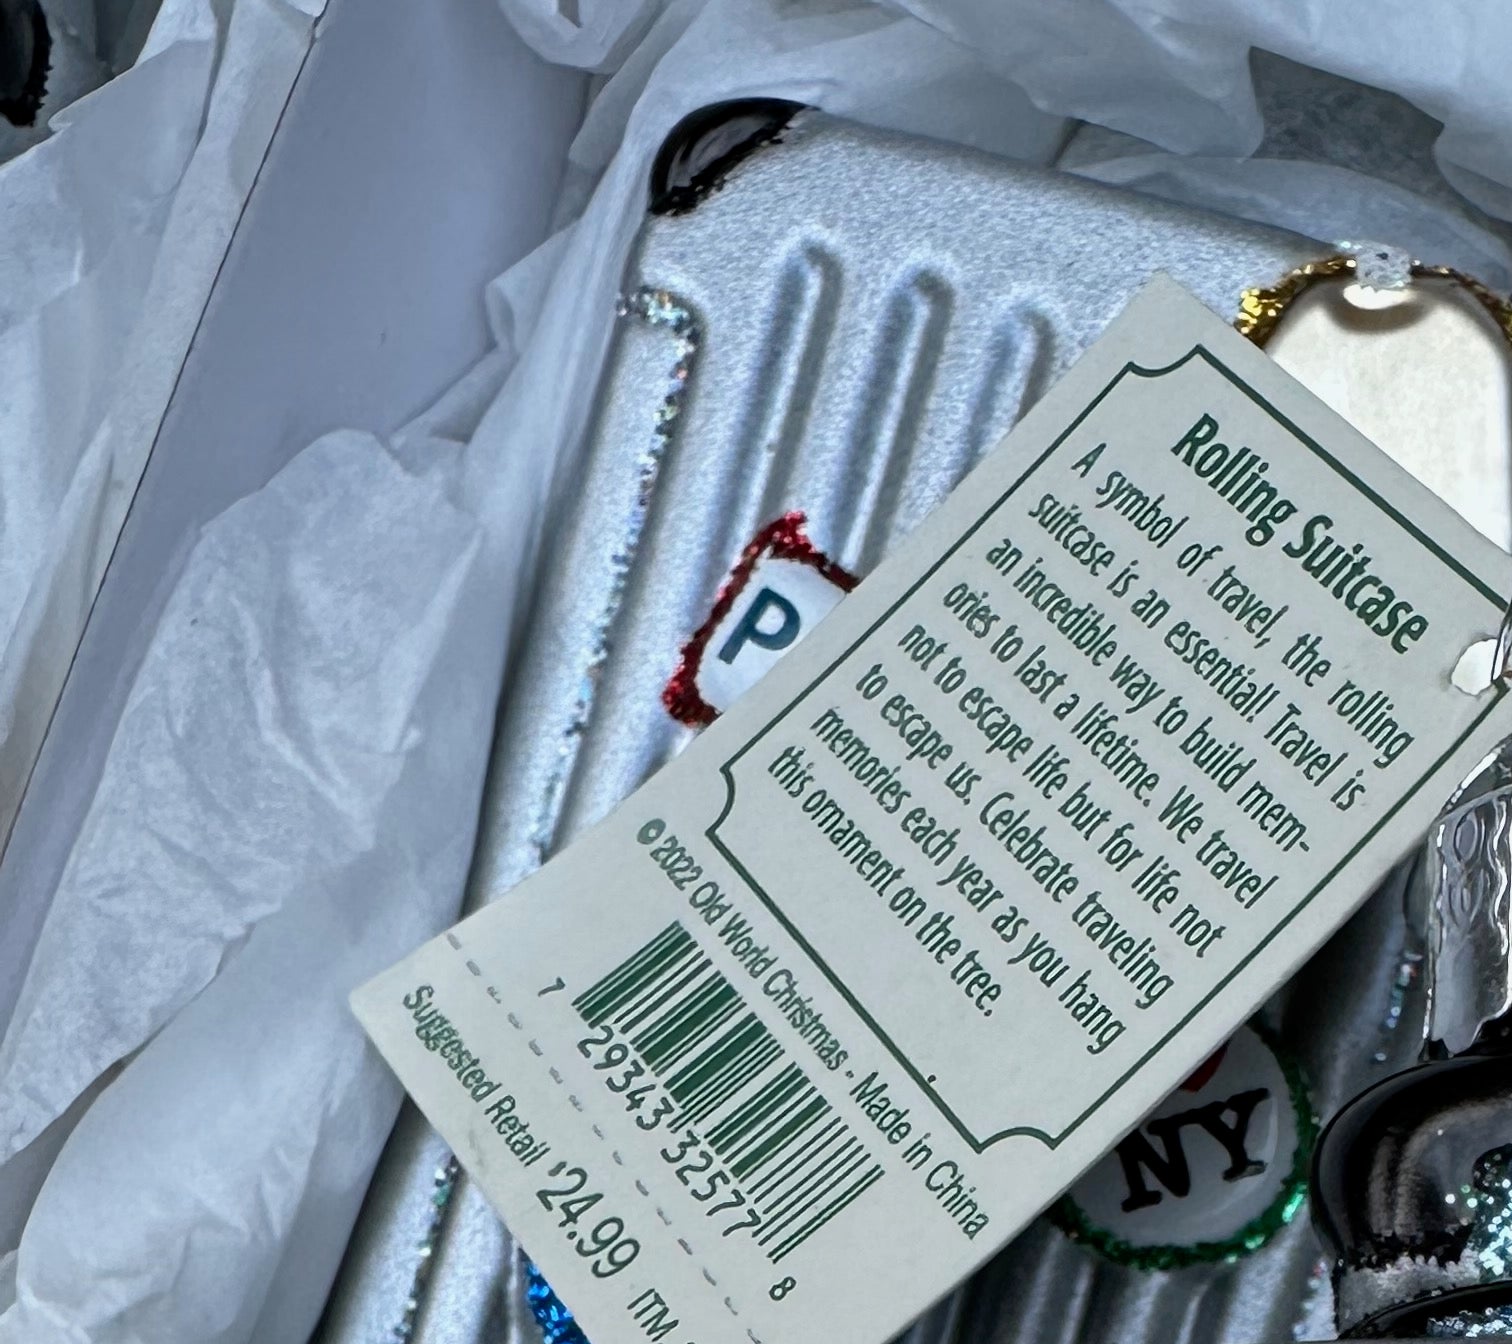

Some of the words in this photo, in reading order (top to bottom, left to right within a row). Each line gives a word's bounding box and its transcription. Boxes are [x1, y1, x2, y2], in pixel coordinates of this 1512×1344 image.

[1028, 493, 1115, 577] suitcase
[1106, 560, 1139, 598] is
[1130, 589, 1171, 629] an
[1164, 621, 1280, 723] essential!
[1264, 702, 1349, 787] Travel
[1330, 769, 1366, 811] is
[1070, 443, 1106, 478] A
[1095, 470, 1190, 549] symbol
[1176, 543, 1219, 577] of
[1207, 565, 1289, 649] travel,
[1281, 633, 1331, 687] the
[1327, 679, 1415, 769] rolling
[1170, 413, 1298, 547] Rolling
[1282, 515, 1429, 654] Suitcase
[810, 708, 911, 814] memories
[898, 624, 949, 672] not
[933, 656, 966, 694] to
[958, 687, 1034, 763] escape
[1022, 744, 1070, 799] life
[1057, 781, 1112, 841] but
[1097, 823, 1144, 872] for
[1131, 855, 1181, 914] life
[1169, 904, 1227, 958] not
[943, 582, 1001, 639] ories
[990, 624, 1024, 663] to
[1013, 645, 1068, 704] last
[1053, 693, 1080, 721] a
[1070, 701, 1160, 808] lifetime.
[1158, 785, 1204, 844] We
[1195, 830, 1279, 909] travel
[986, 538, 1023, 576] an
[1013, 557, 1117, 666] incredible
[1109, 654, 1166, 714] way
[1152, 696, 1189, 735] to
[1179, 716, 1257, 793] build
[1236, 780, 1309, 852] mem-
[768, 746, 815, 798] this
[802, 789, 905, 897] ornament
[888, 887, 927, 927] on
[915, 912, 961, 964] the
[950, 950, 1001, 1017] tree.
[856, 663, 888, 700] to
[880, 694, 953, 770] escape
[944, 761, 982, 805] us.
[980, 792, 1079, 903] Celebrate
[1072, 891, 1174, 1010] traveling
[900, 807, 961, 866] each
[936, 855, 1004, 913] year
[991, 906, 1029, 943] as
[403, 986, 502, 1101] Suggested
[484, 1095, 551, 1167] Retail
[689, 882, 733, 926] Old
[718, 912, 773, 979] World
[762, 969, 848, 1070] Christmas
[849, 1072, 912, 1145] Made
[901, 1133, 933, 1171] in
[925, 1160, 989, 1240] China
[1007, 932, 1070, 988] you
[1058, 969, 1127, 1055] hang
[1113, 1088, 1269, 1213] NY
